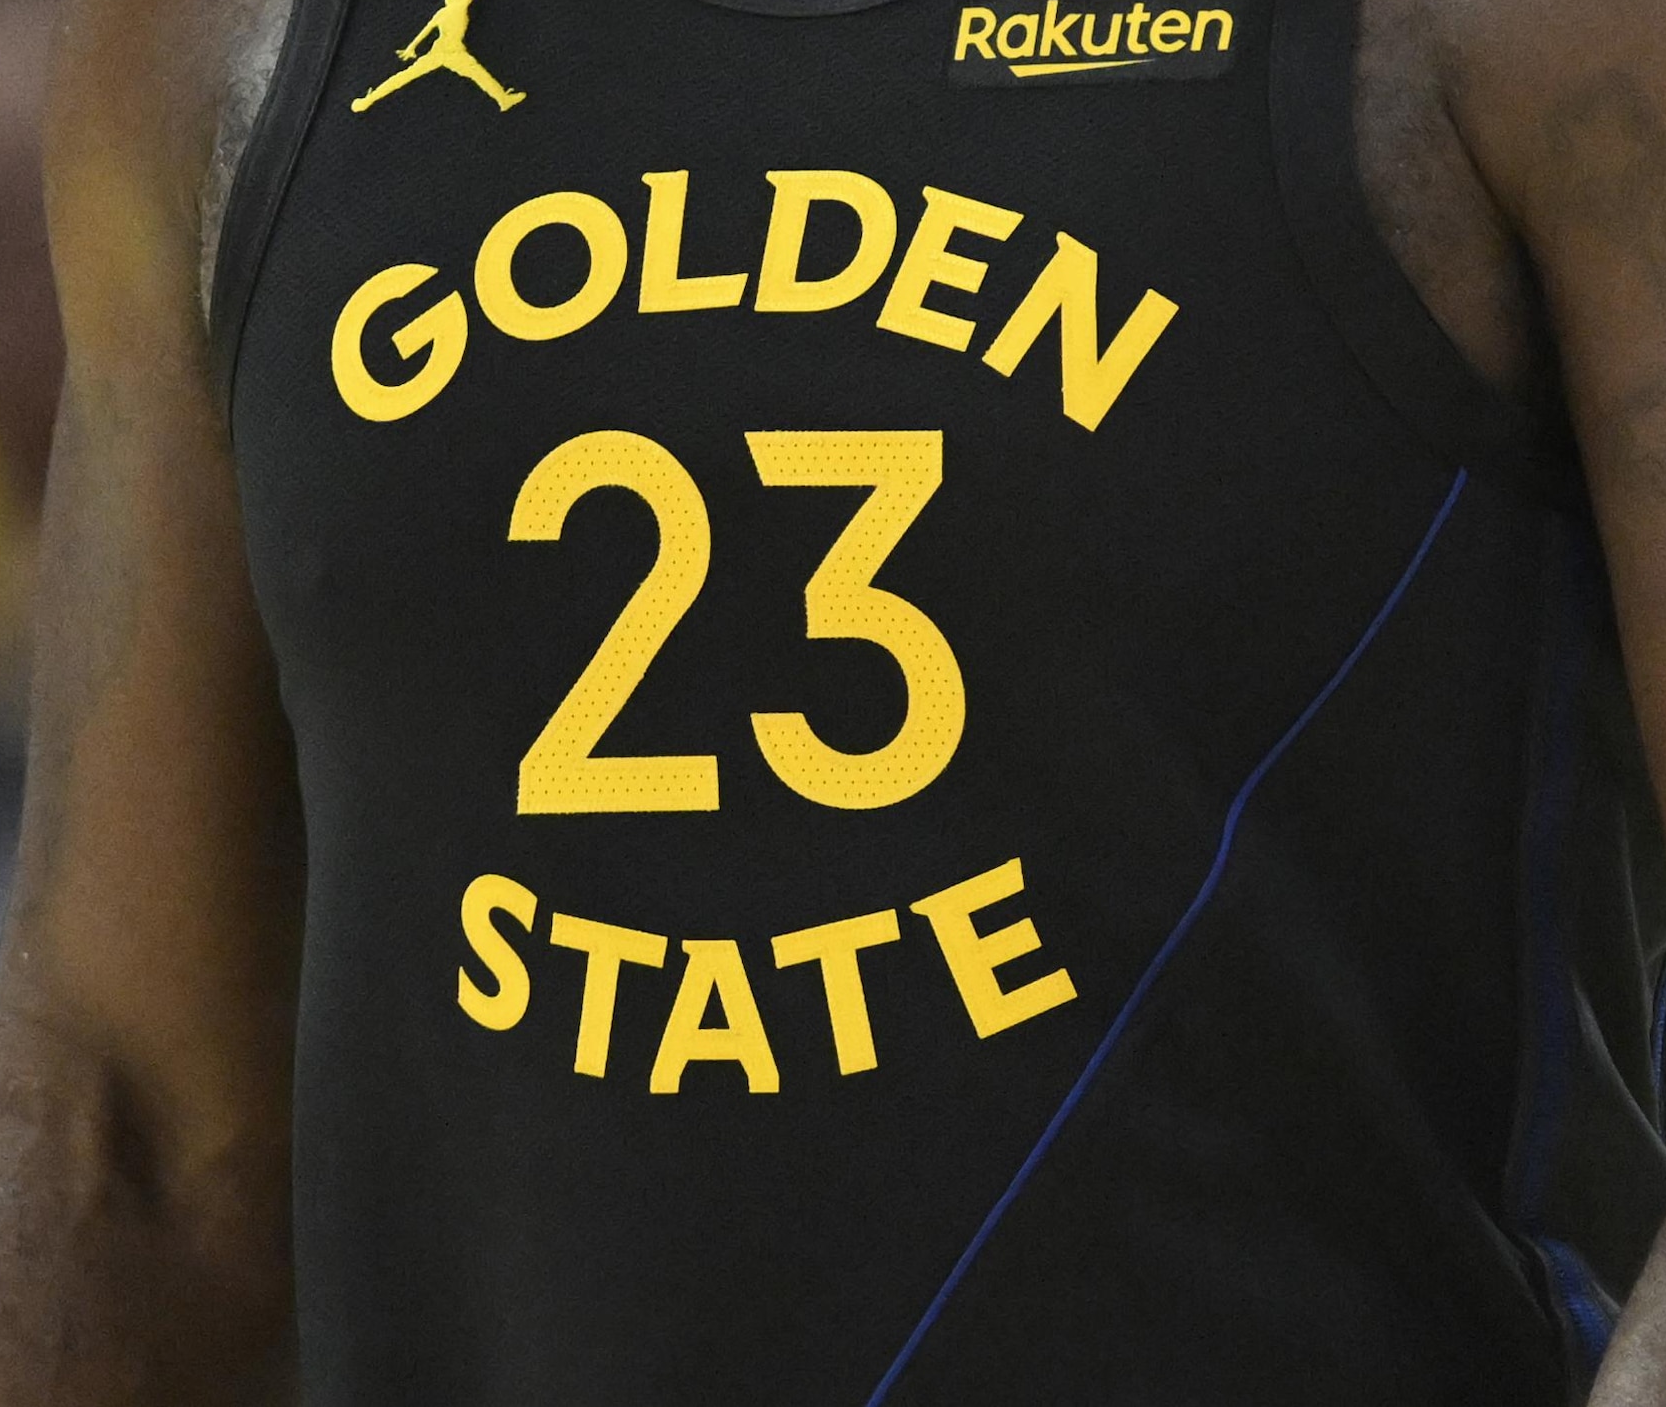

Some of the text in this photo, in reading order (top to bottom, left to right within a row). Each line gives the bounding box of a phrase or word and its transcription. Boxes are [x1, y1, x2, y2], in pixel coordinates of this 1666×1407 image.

[330, 169, 1180, 433] GOLDEN
[507, 428, 968, 815] 23
[456, 855, 1079, 1096] STATE
